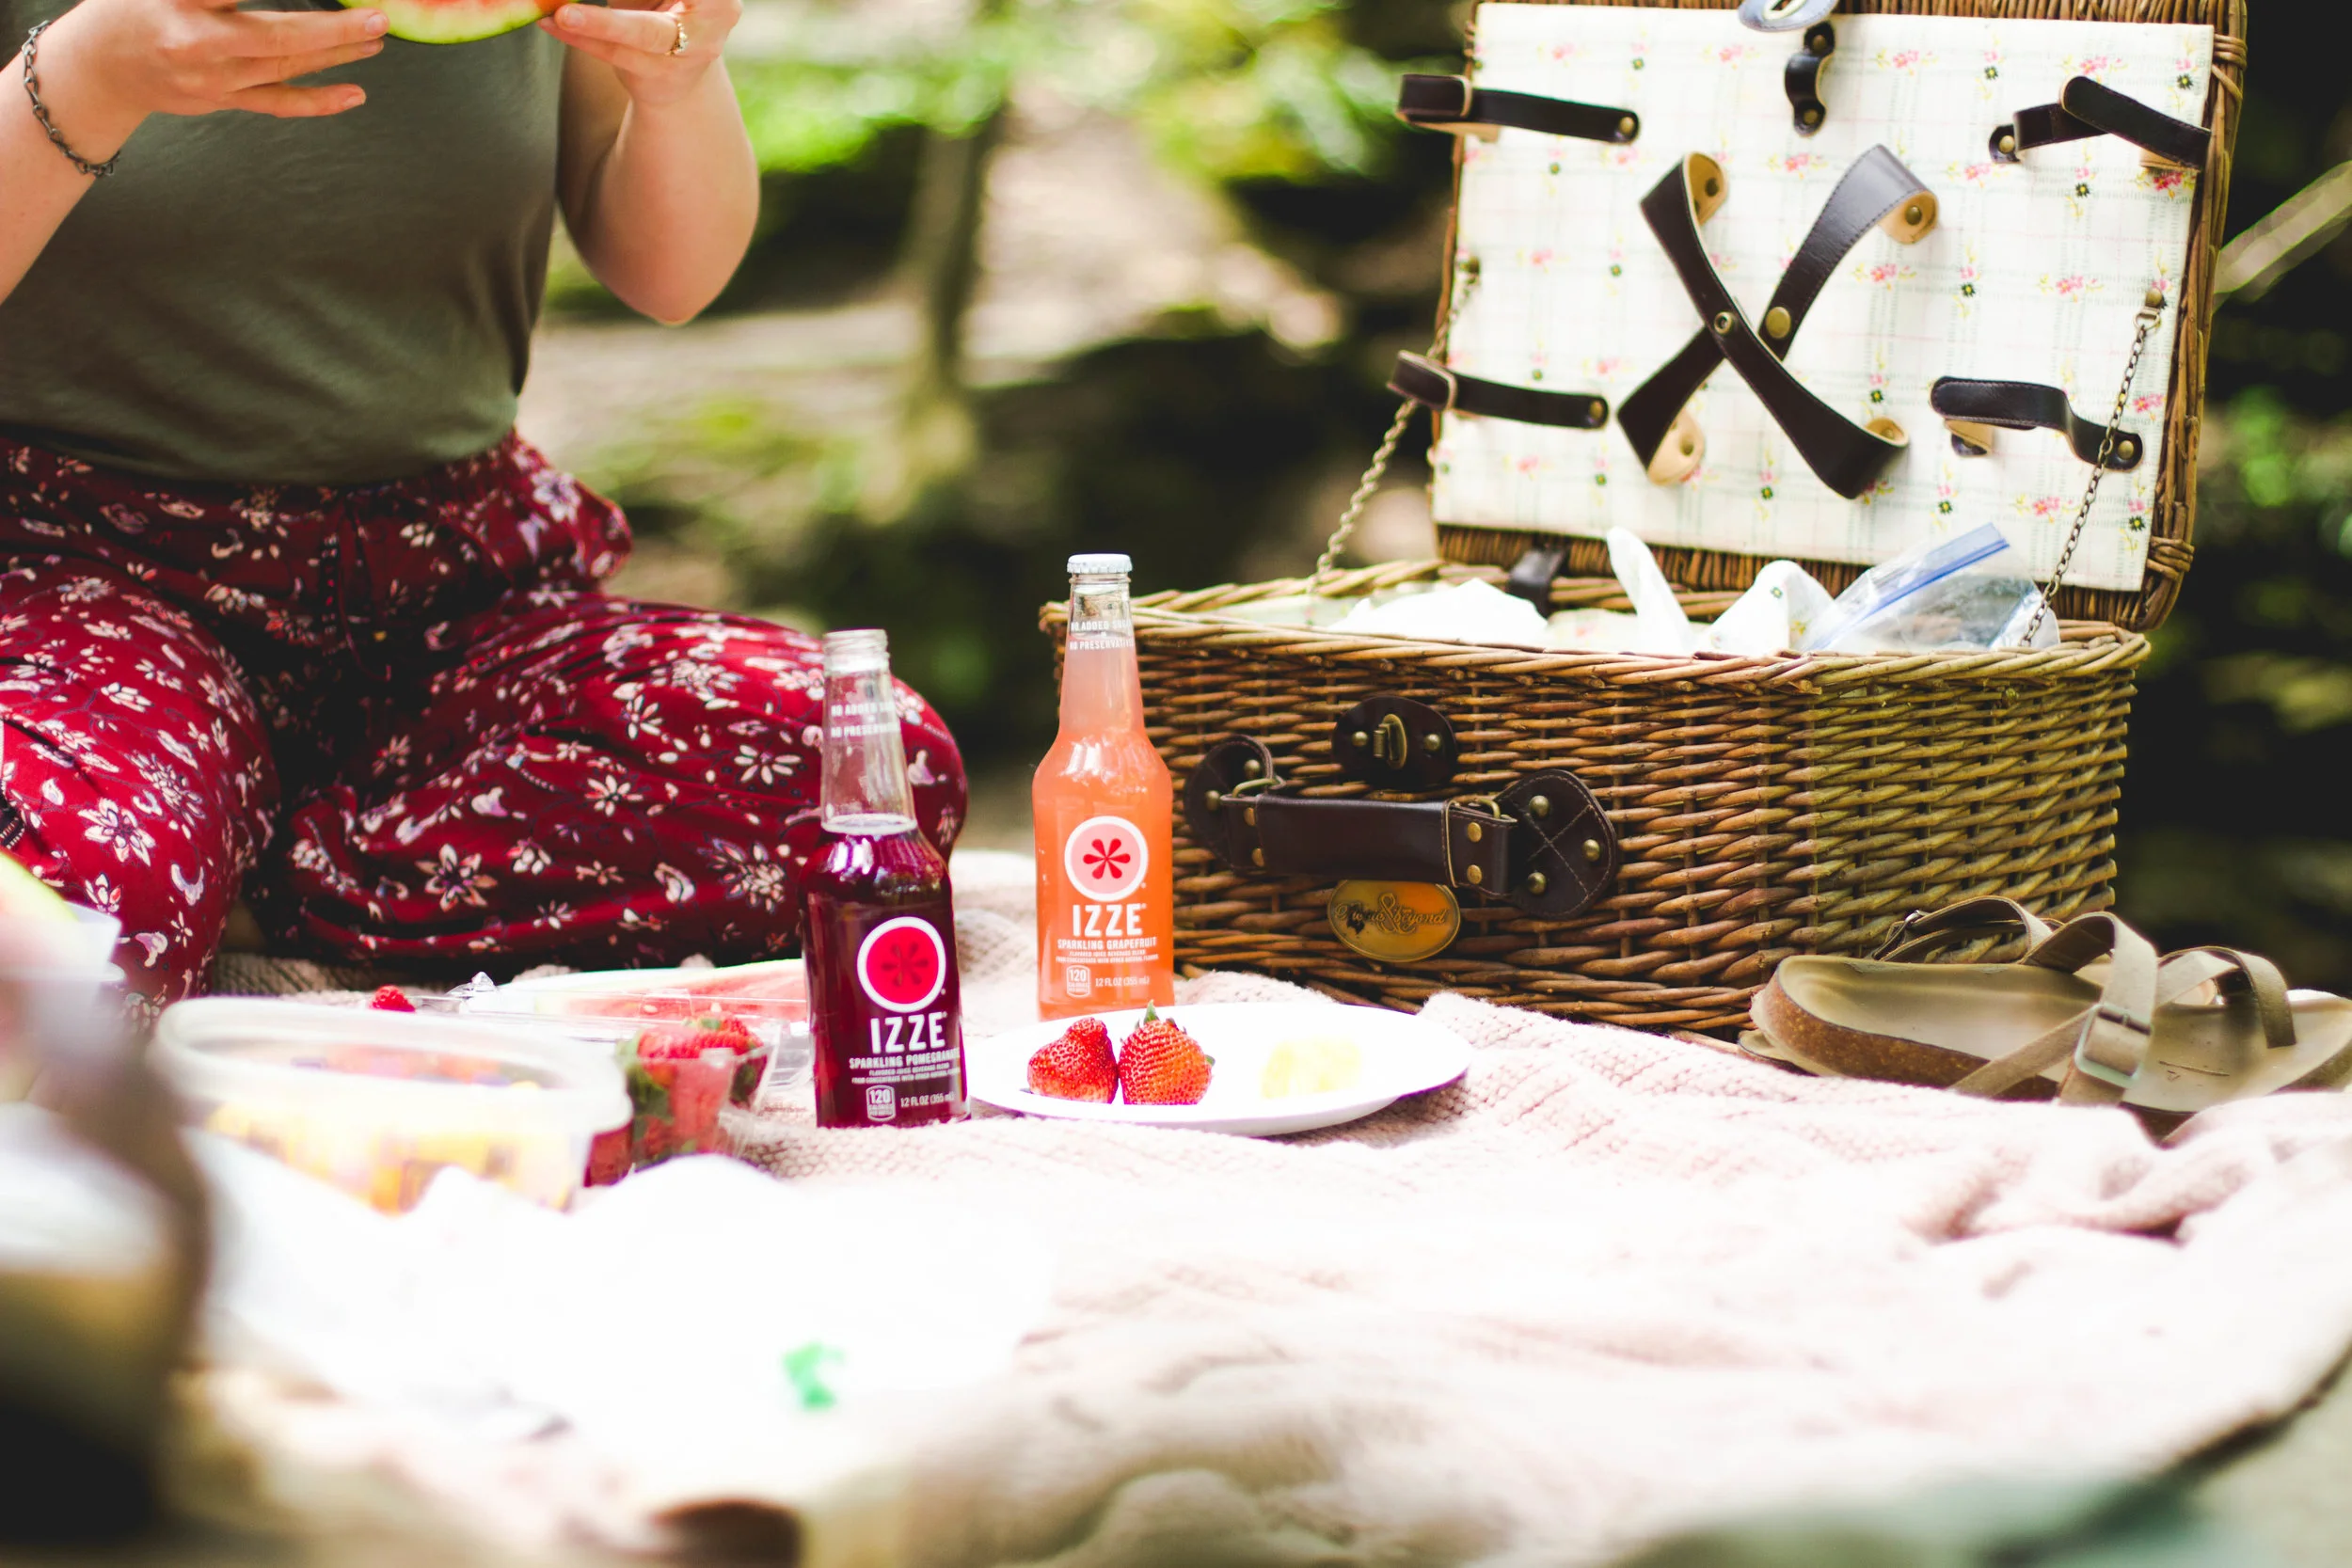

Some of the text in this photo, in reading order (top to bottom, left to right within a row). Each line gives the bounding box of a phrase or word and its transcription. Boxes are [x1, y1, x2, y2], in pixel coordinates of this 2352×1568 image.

[1082, 621, 1109, 630] ADDED
[1073, 903, 1142, 937] IZZE
[1057, 937, 1157, 950] SPARKLING GRAPEFRUIT
[1069, 969, 1087, 982] 120
[1095, 978, 1103, 987] 12
[1113, 977, 1121, 986] OZ
[871, 1012, 945, 1053] IZZE
[849, 1055, 903, 1069] SPARKLING
[870, 1089, 891, 1103] 120
[900, 1097, 910, 1107] 12
[919, 1095, 930, 1105] OZ
